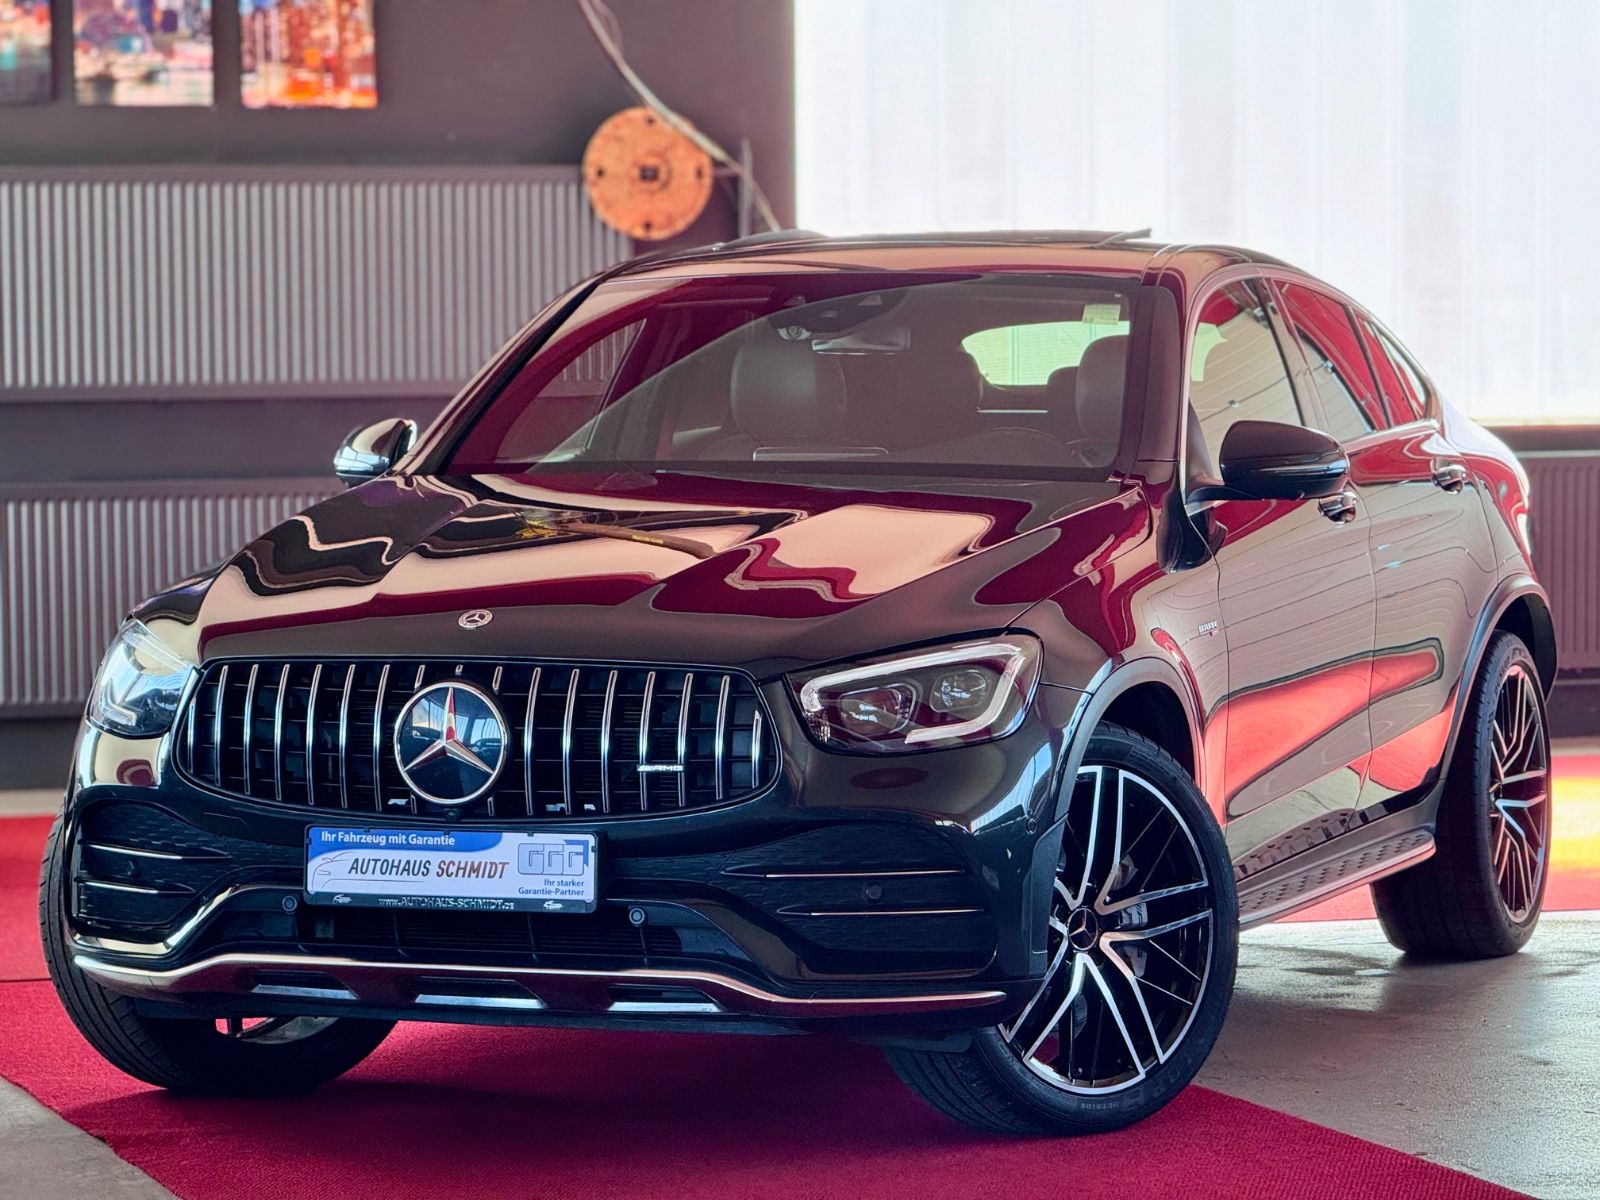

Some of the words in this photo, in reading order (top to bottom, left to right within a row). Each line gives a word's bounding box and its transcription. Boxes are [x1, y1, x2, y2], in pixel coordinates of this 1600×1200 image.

[321, 830, 335, 842] Ihr
[338, 831, 386, 846] Fahrzeug
[388, 832, 407, 844] mit
[408, 833, 456, 846] Garantie
[348, 857, 431, 877] AUTOHAUS
[436, 859, 509, 879] SCHMIDT
[544, 877, 555, 887] Ihr
[556, 879, 585, 888] starker
[518, 886, 585, 896] Garantie-Partner
